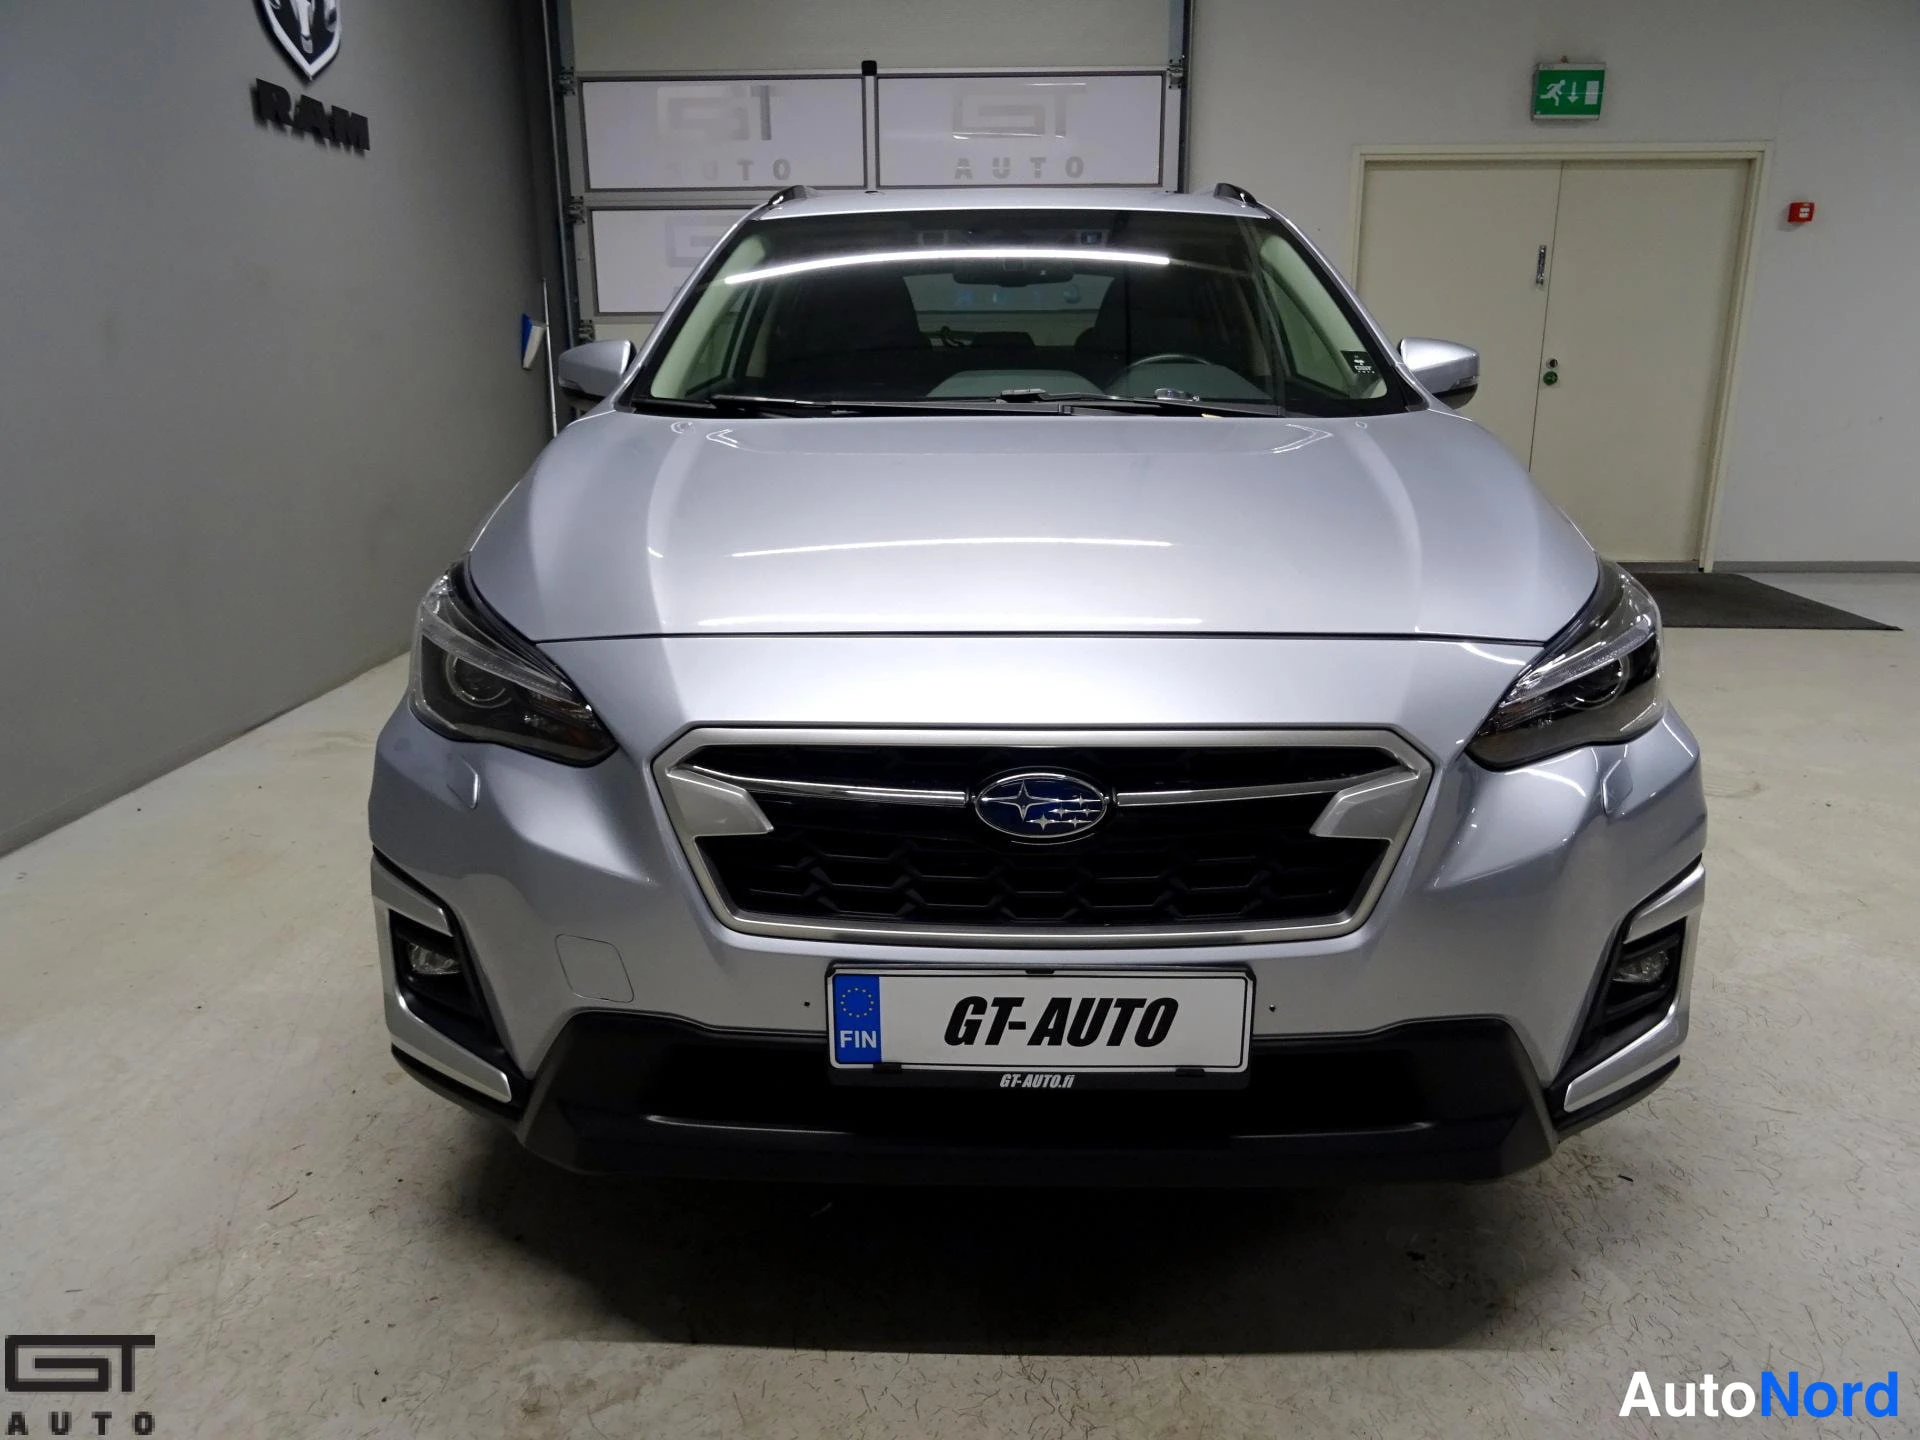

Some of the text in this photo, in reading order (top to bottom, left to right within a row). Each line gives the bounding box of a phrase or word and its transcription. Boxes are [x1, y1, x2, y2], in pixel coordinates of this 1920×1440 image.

[255, 78, 371, 151] RAM
[954, 156, 1084, 179] AUTO
[944, 996, 1179, 1047] GT-AUTO
[840, 1030, 877, 1048] FIN
[999, 1073, 1075, 1088] GT-AUTO.fi
